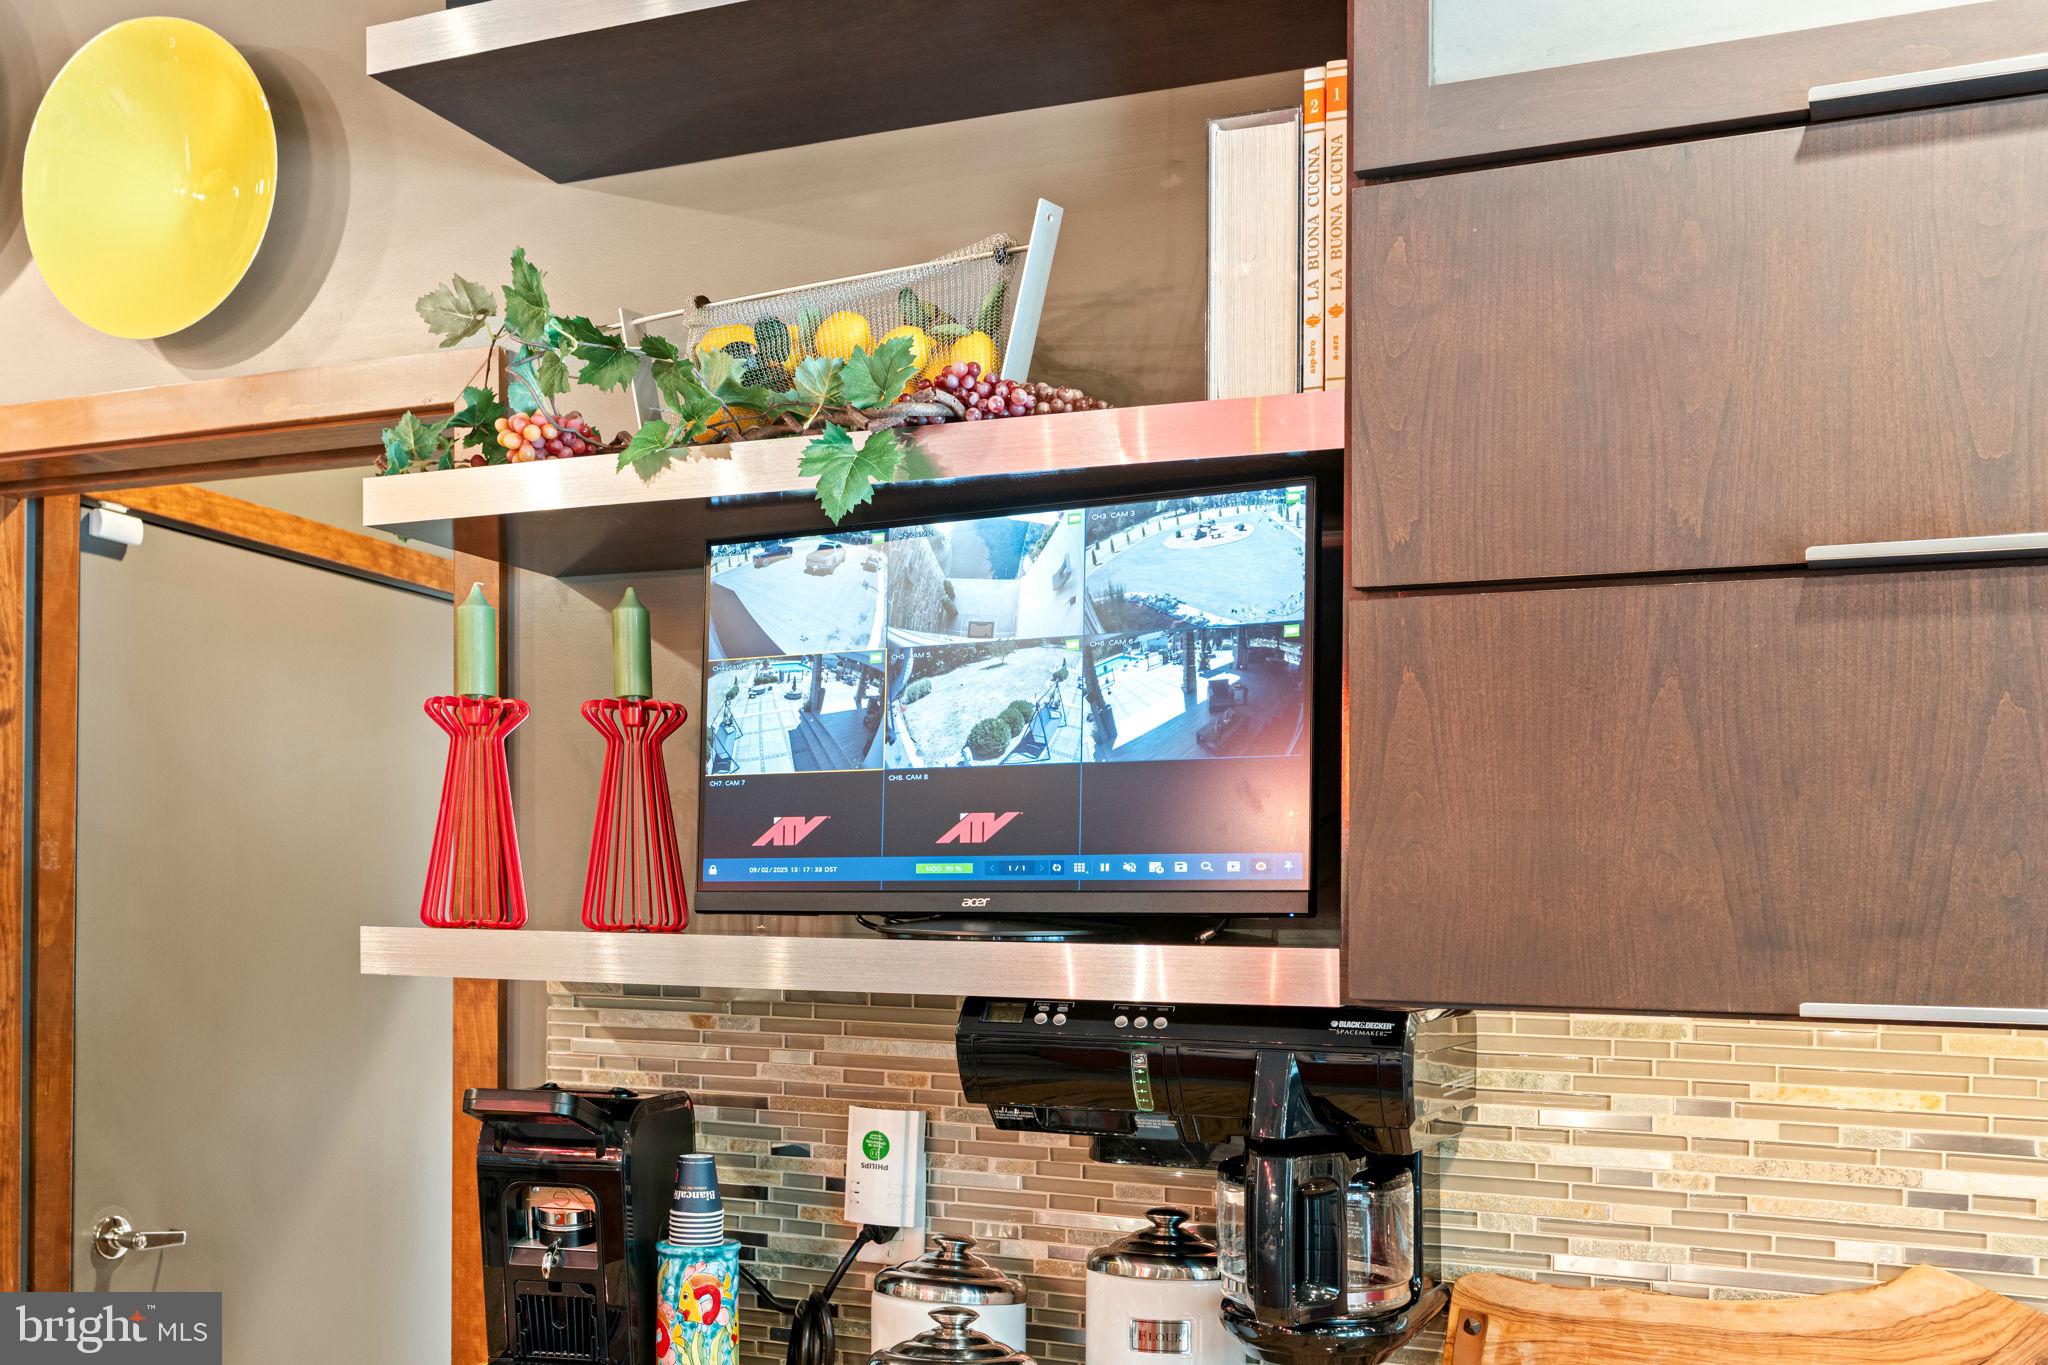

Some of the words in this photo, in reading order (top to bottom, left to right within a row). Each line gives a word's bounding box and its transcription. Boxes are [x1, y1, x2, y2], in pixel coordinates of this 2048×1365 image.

[1334, 87, 1340, 101] 1
[1310, 98, 1319, 113] 2
[1330, 134, 1343, 196] CUCINA
[1308, 145, 1320, 207] CUCINA
[1330, 203, 1343, 260] BUONA
[1307, 214, 1320, 271] BUONA
[1330, 269, 1343, 291] LA
[1307, 279, 1320, 301] LA
[1308, 340, 1316, 374] asp-bro
[1110, 511, 1129, 519] CAM
[725, 779, 740, 787] CAM
[961, 897, 990, 907] acer
[1335, 1029, 1384, 1037] SPACEMAKER
[860, 1162, 889, 1171] PHILIPS
[1138, 1330, 1182, 1343] FLOUR
